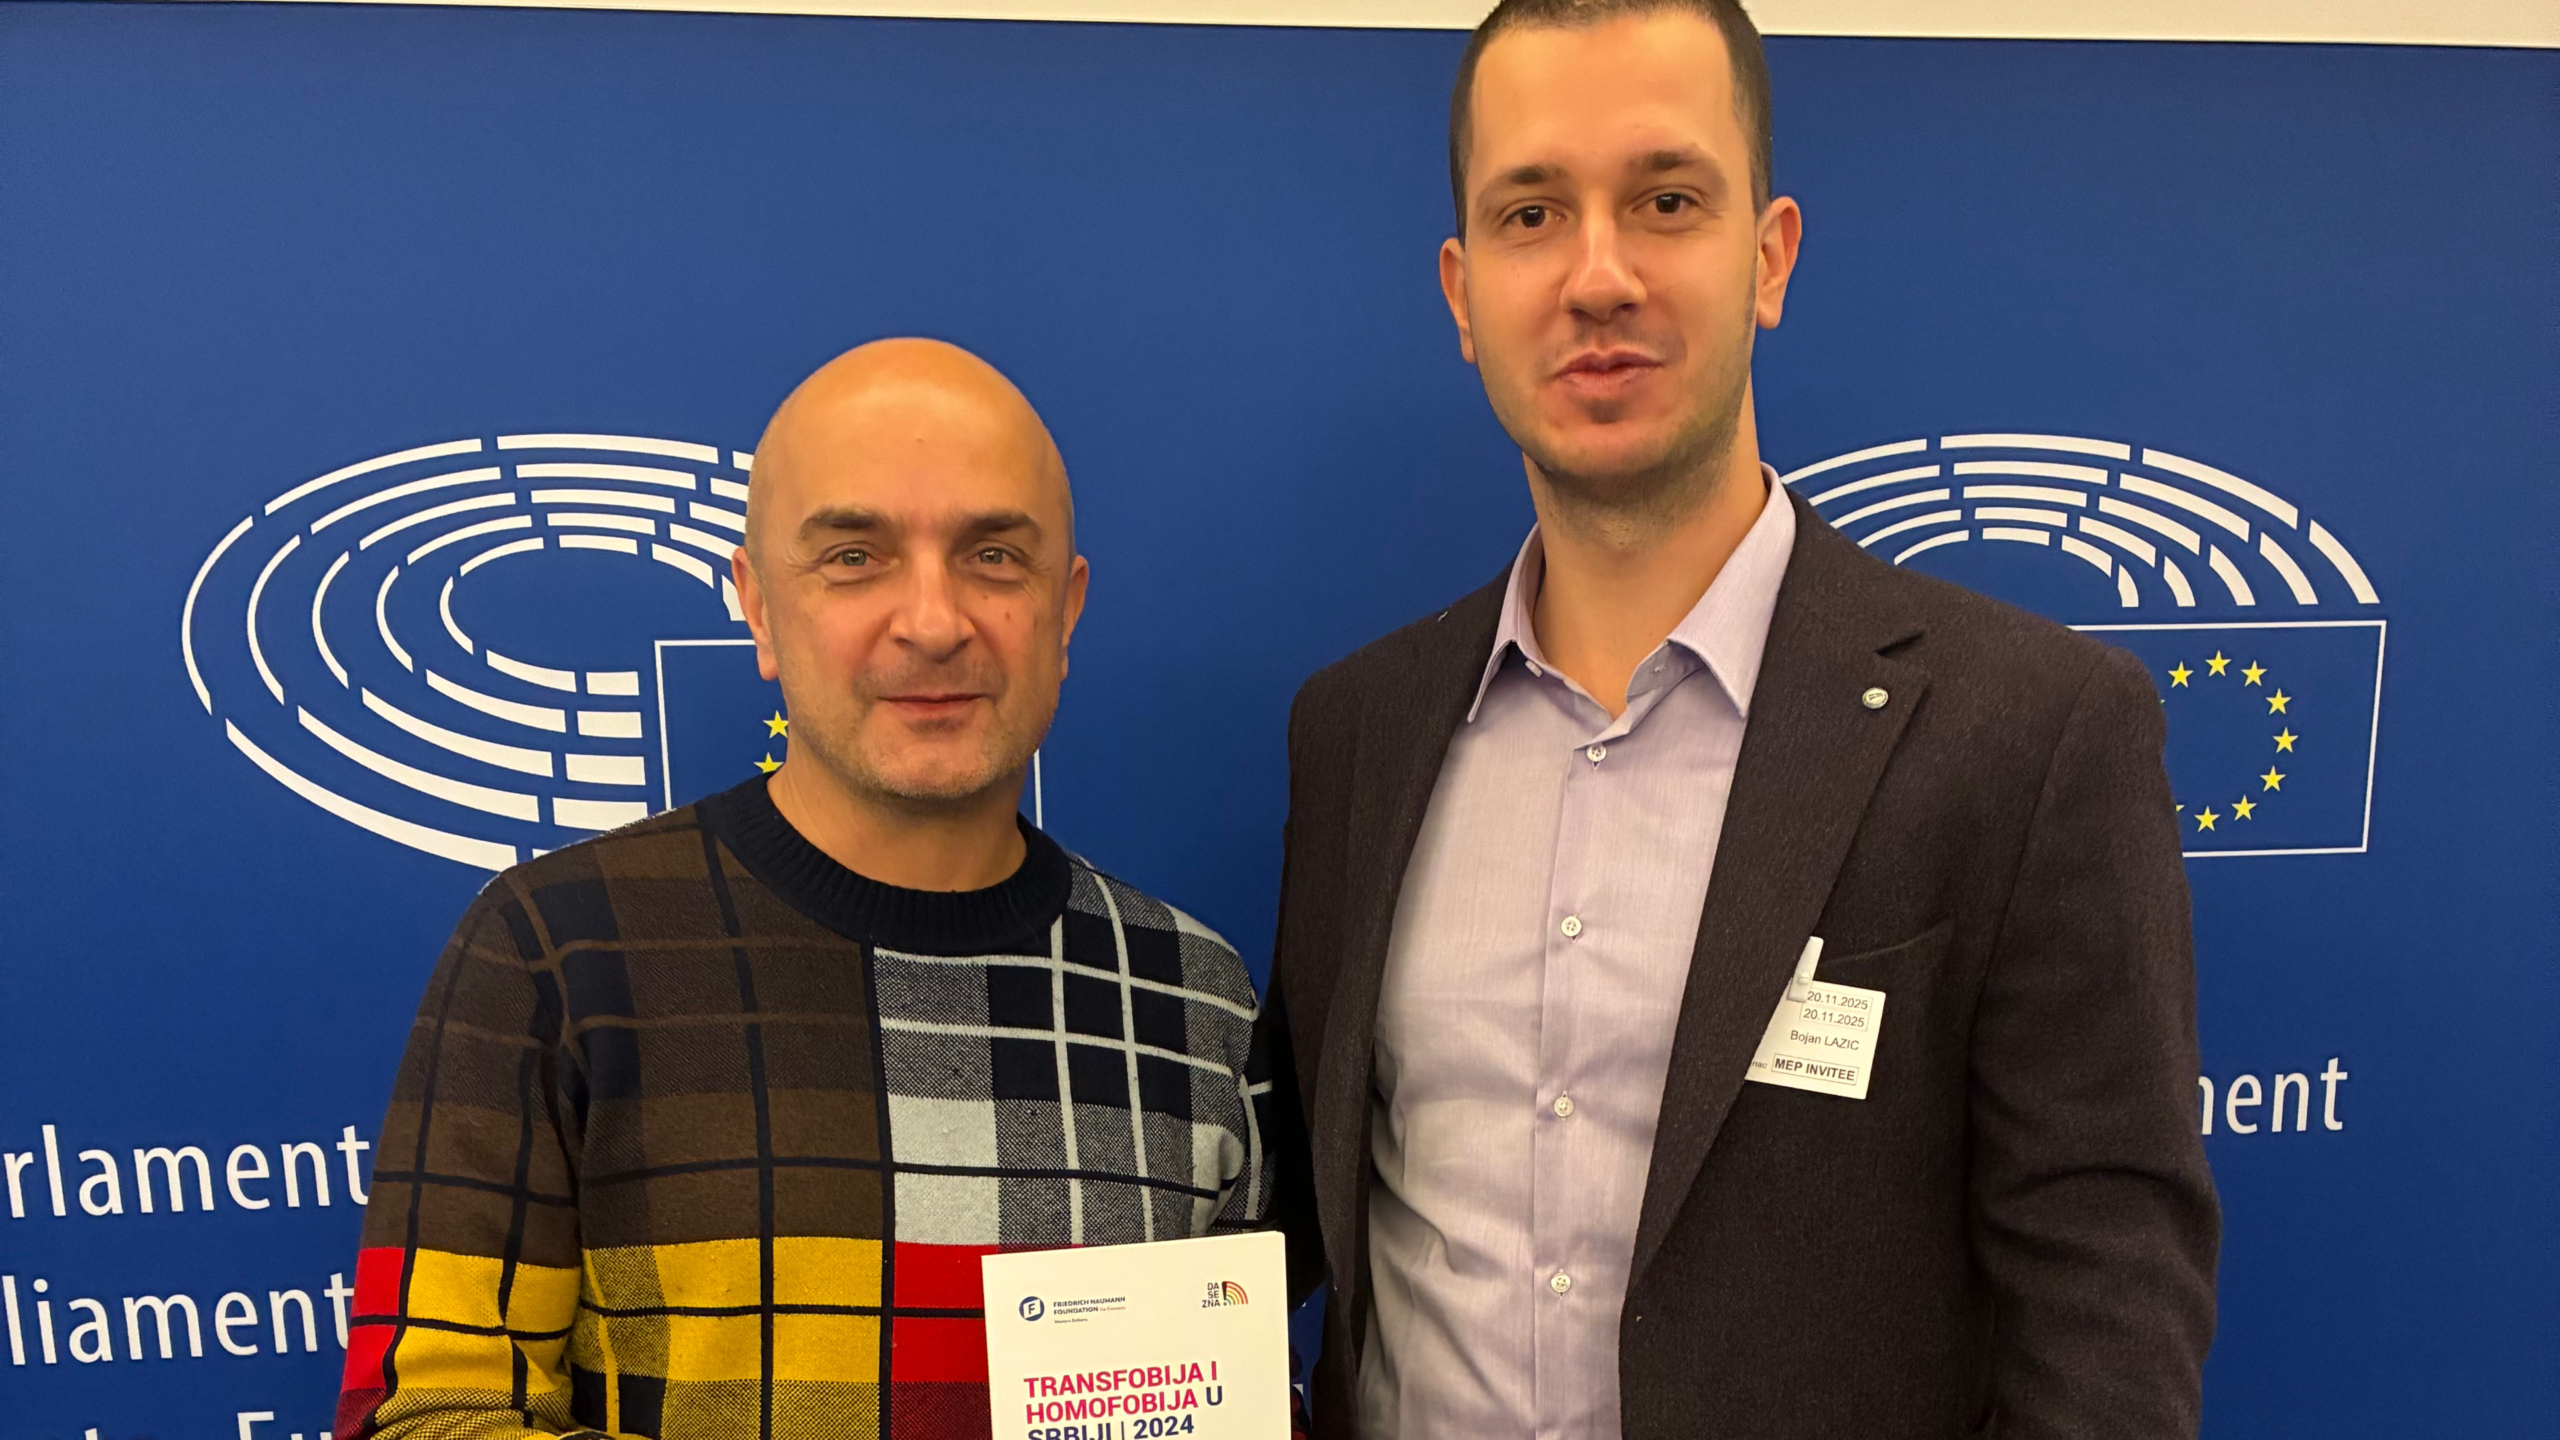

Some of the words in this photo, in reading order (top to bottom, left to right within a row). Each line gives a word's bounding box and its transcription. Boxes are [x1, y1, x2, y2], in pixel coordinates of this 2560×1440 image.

[1807, 991, 1868, 1010] 20.11.2025
[1803, 1008, 1865, 1028] 20.11.2025
[1790, 1030, 1821, 1045] Bojan
[1825, 1036, 1860, 1051] LAZIC
[1774, 1058, 1803, 1072] MEP
[1805, 1063, 1856, 1082] INVITEE
[2199, 1057, 2348, 1135] ent
[4, 1124, 370, 1218] rlament
[1207, 1282, 1220, 1291] DA
[1207, 1290, 1220, 1299] SE
[1053, 1306, 1099, 1315] FOUNDATION
[1201, 1299, 1221, 1308] ZNA
[2, 1272, 355, 1366] liament
[1023, 1362, 1204, 1398] TRANSFOBIJA
[1211, 1361, 1217, 1381] I
[1026, 1388, 1199, 1425] HOMOFOBIJA
[1206, 1385, 1223, 1406] U
[1133, 1414, 1194, 1440] 2024
